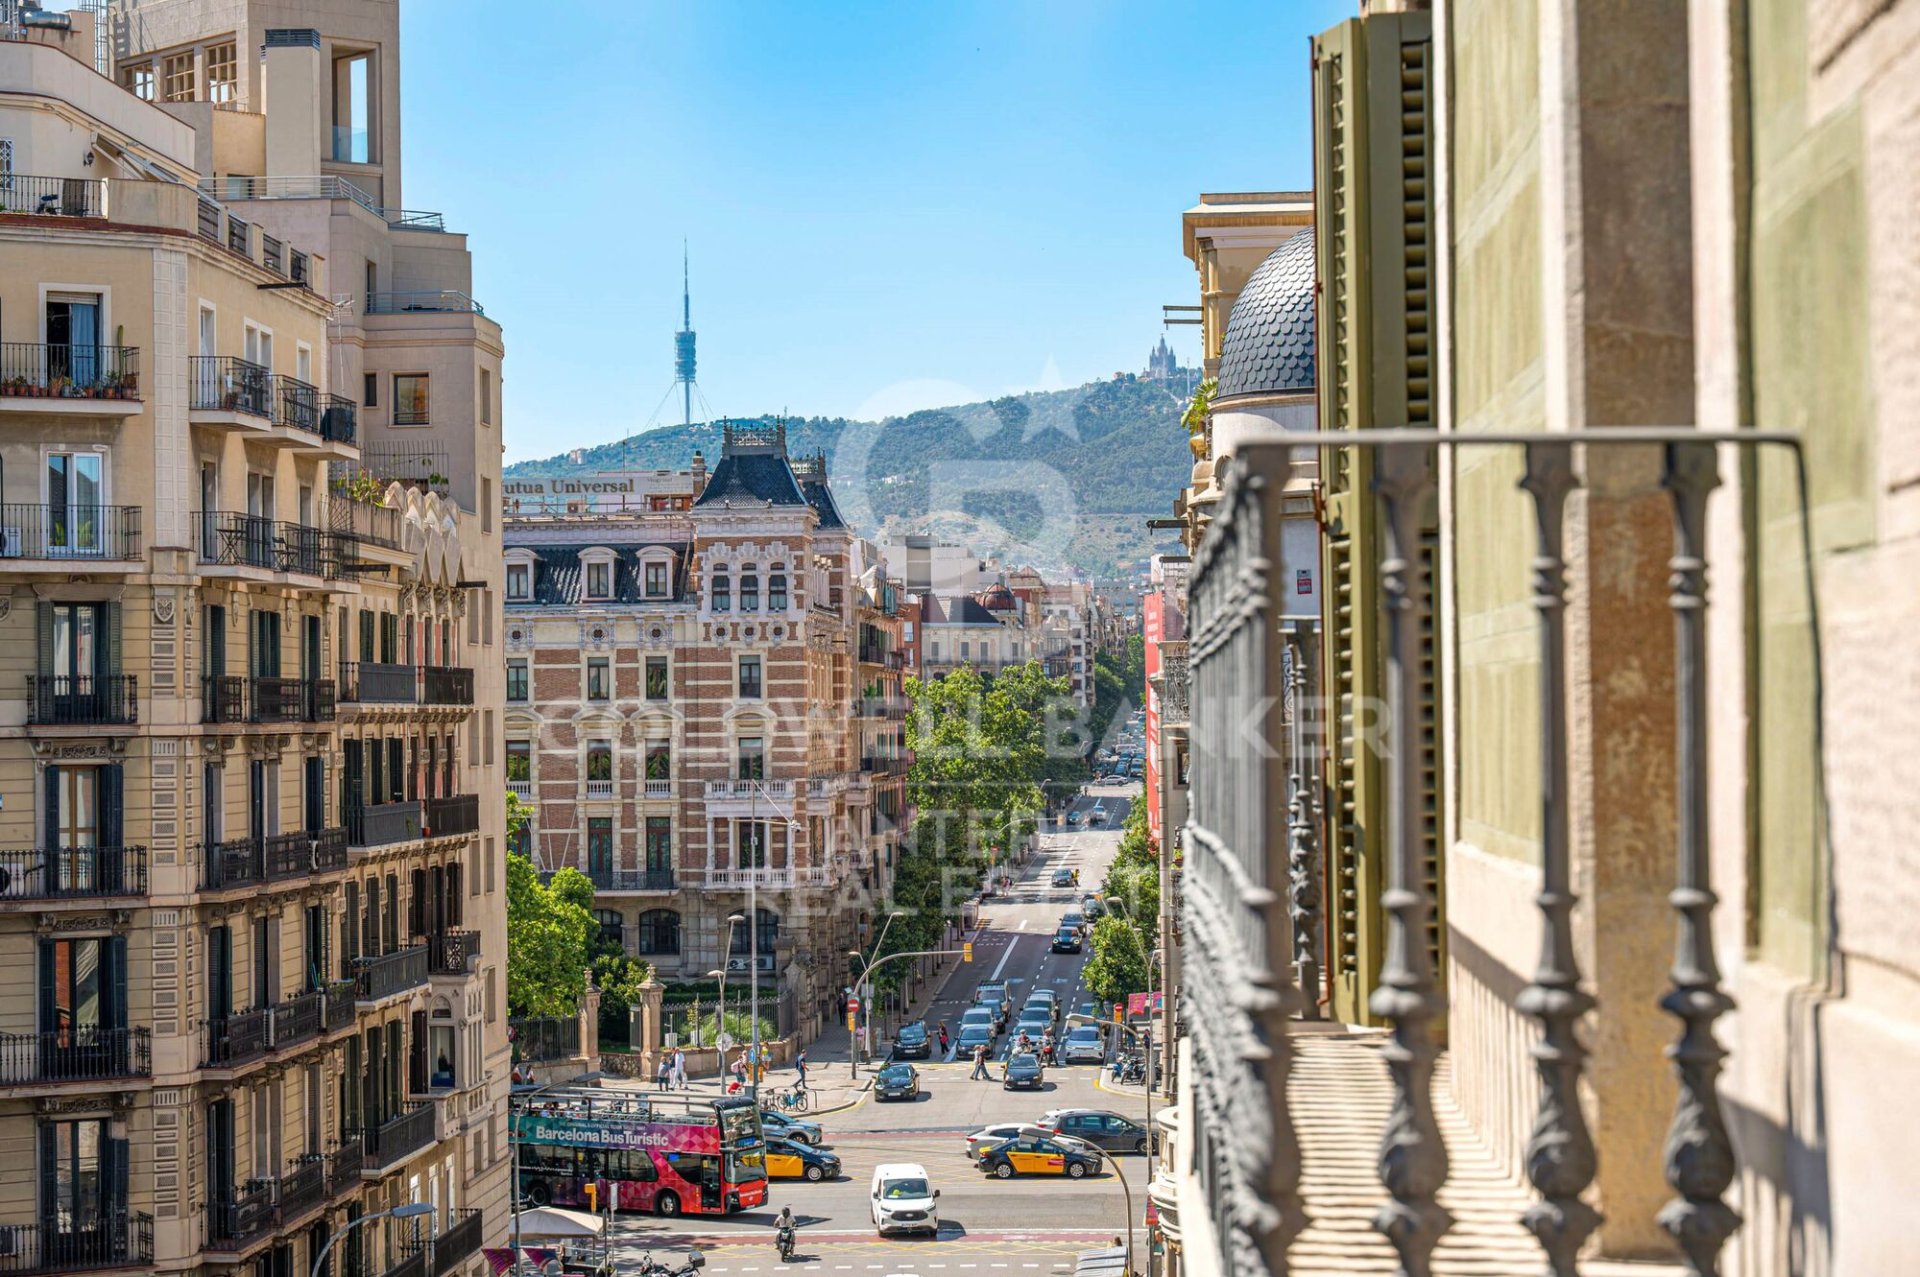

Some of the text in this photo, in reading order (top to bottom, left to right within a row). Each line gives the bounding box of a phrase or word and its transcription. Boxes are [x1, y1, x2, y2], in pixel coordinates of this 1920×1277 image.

[502, 481, 544, 494] utua
[551, 479, 634, 494] Universal
[536, 1125, 600, 1143] Barcelona
